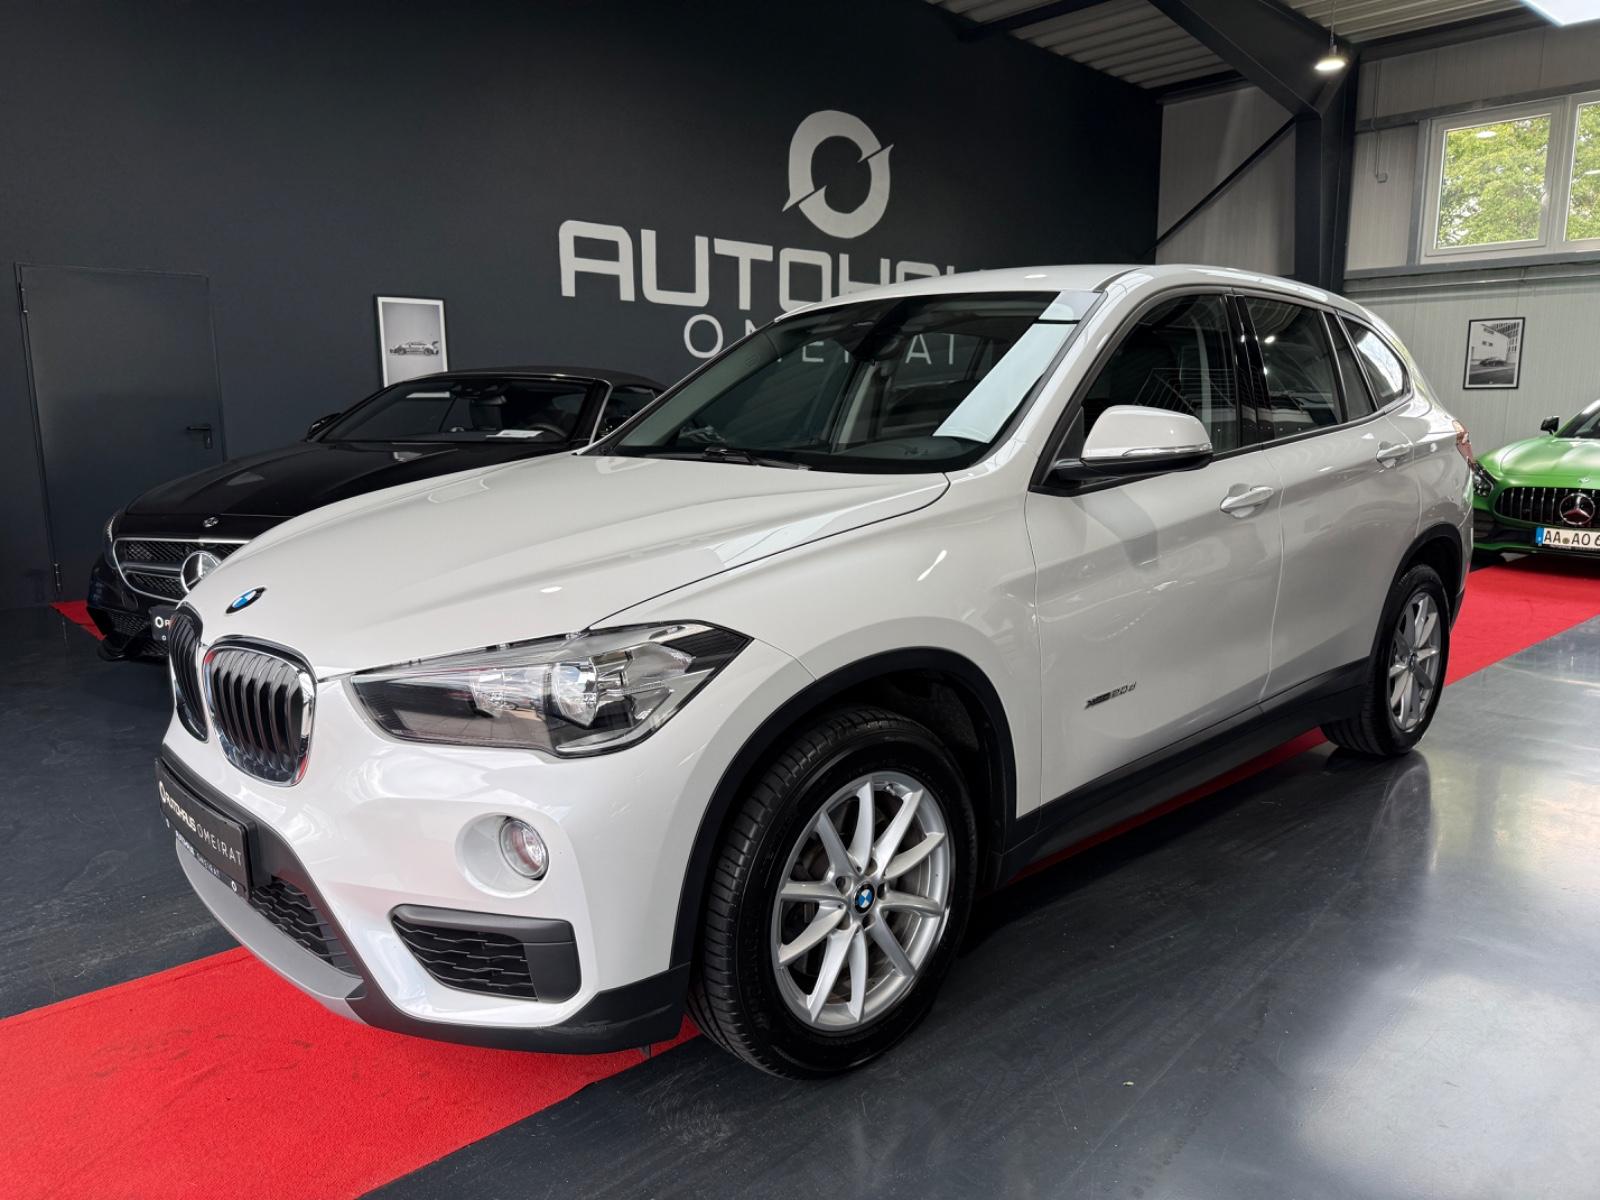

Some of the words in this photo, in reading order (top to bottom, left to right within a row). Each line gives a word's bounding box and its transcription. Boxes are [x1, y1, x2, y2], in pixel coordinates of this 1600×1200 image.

[559, 220, 955, 313] AUTOH
[1544, 530, 1561, 544] AA
[1571, 532, 1591, 546] AO
[196, 823, 242, 867] OMEIRAT
